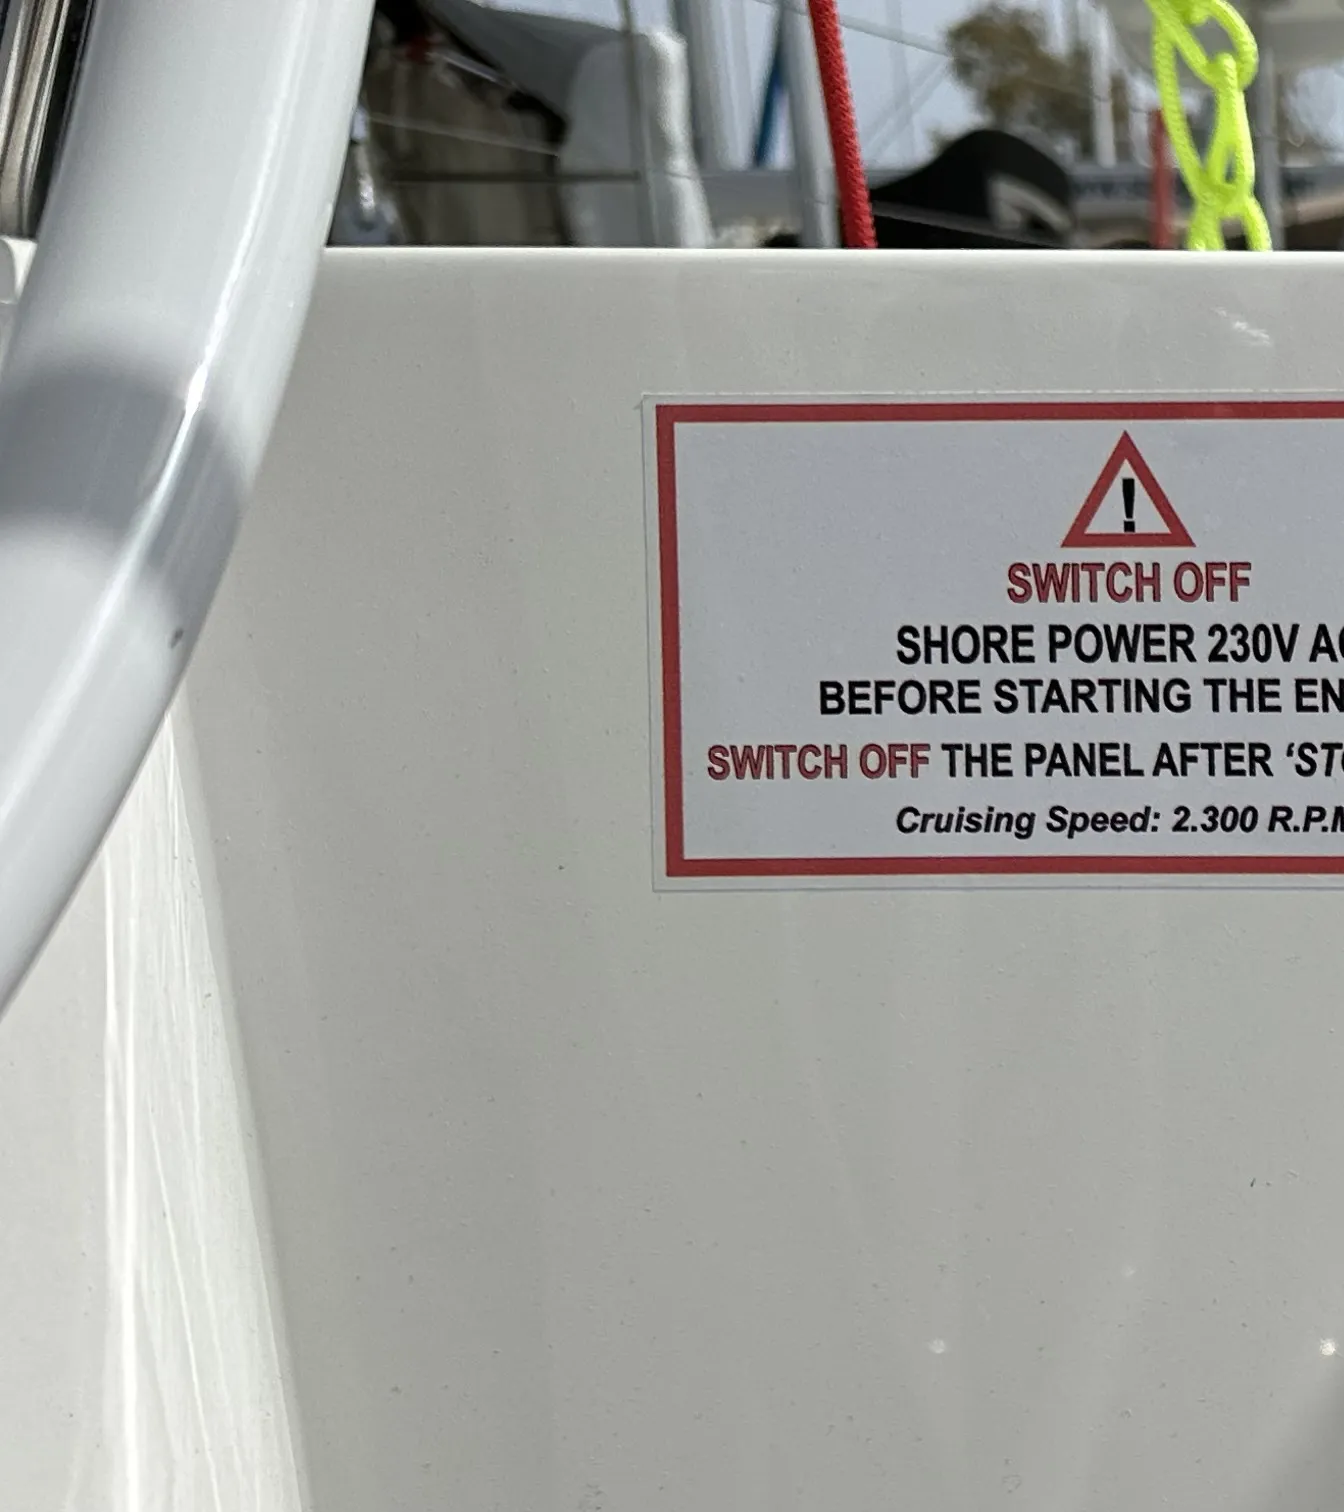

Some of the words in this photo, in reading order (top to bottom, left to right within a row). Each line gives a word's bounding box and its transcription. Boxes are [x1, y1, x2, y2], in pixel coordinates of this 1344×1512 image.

[1007, 562, 1160, 604] SWITCH
[1173, 561, 1252, 603] OFF
[896, 624, 1036, 665] SHORE
[1048, 623, 1197, 664] POWER
[1207, 623, 1300, 663] 230V
[819, 680, 982, 715] BEFORE
[994, 678, 1192, 714] STARTING
[1203, 678, 1282, 713] THE
[708, 744, 848, 781] SWITCH
[860, 744, 931, 780] OFF
[941, 743, 1014, 778] THE
[1025, 743, 1145, 777] PANEL
[1152, 742, 1274, 777] AFTER
[896, 805, 1036, 840] Cruising
[1046, 805, 1161, 840] Speed:
[1171, 805, 1259, 834] 2.300
